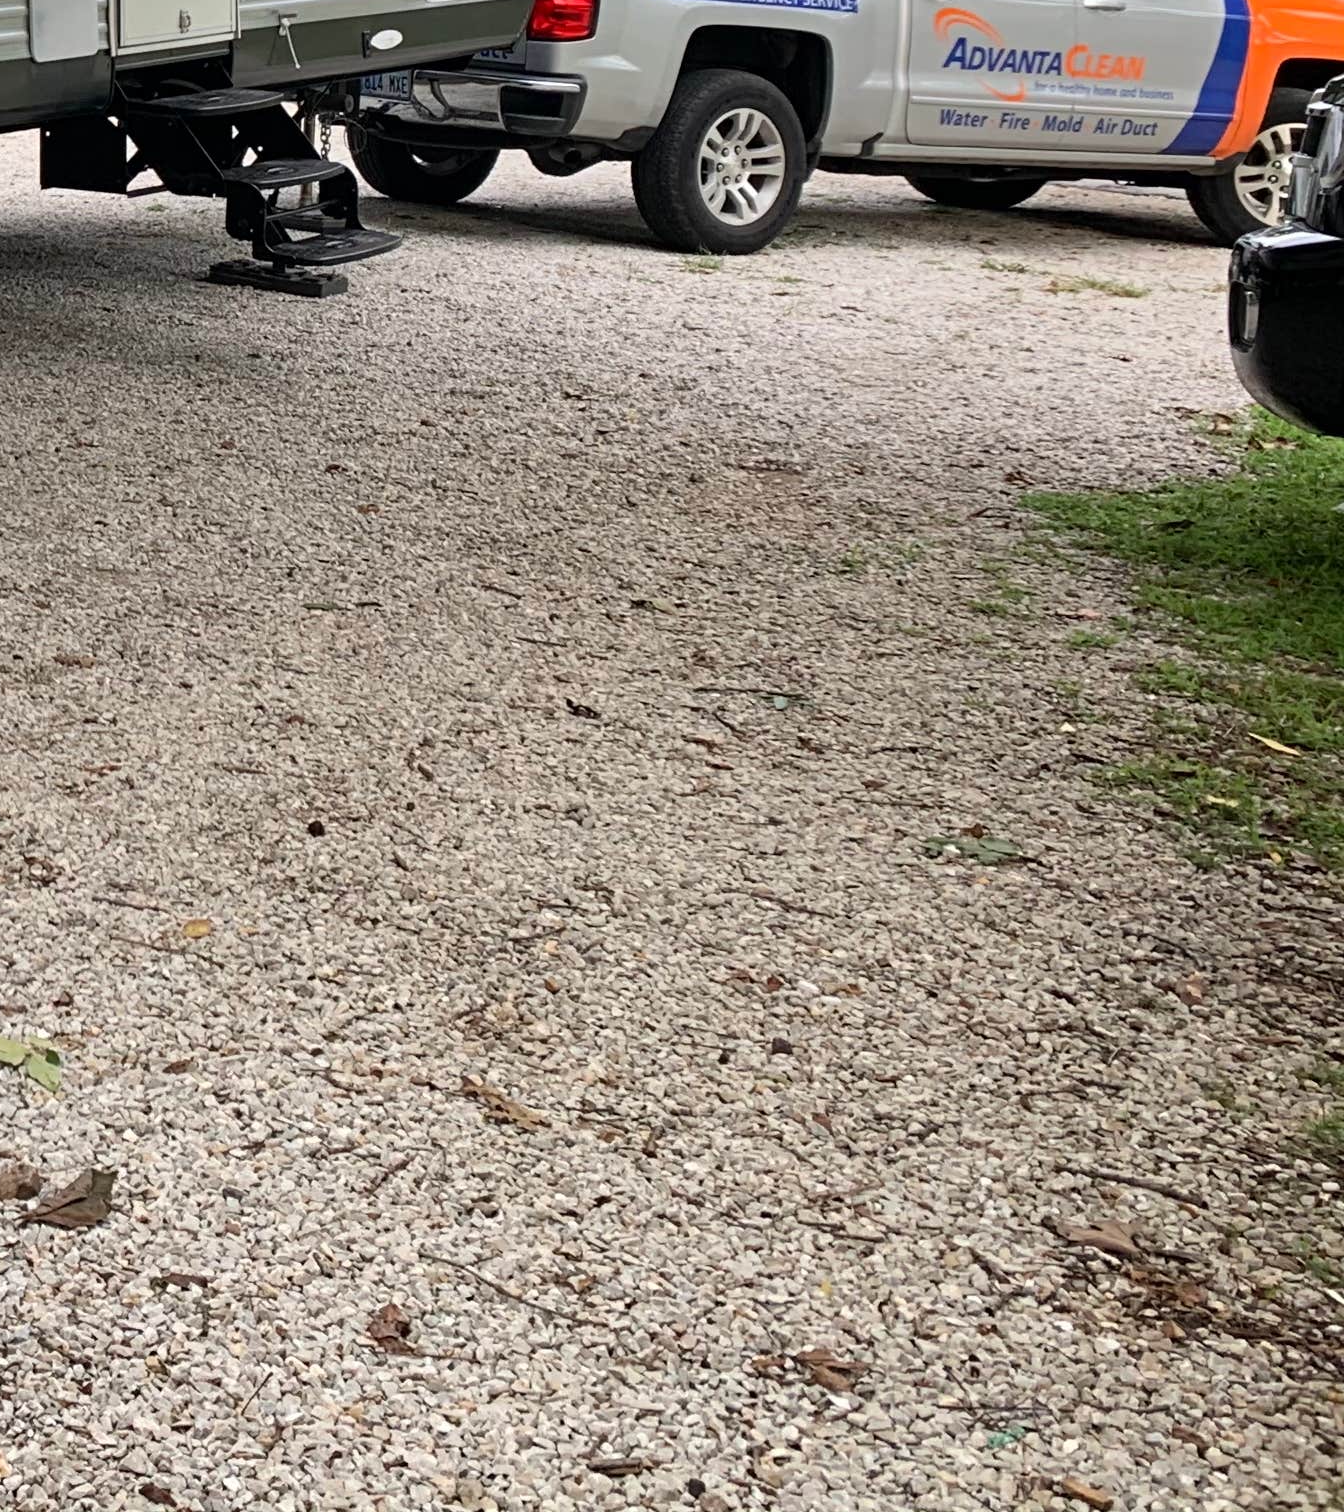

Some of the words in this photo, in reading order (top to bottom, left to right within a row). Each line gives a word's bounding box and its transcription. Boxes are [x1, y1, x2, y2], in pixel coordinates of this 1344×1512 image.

[939, 109, 988, 128] Water
[999, 112, 1030, 130] Fire
[1041, 115, 1083, 133] Mold
[1093, 118, 1116, 135] Air
[1121, 119, 1159, 136] Duct
